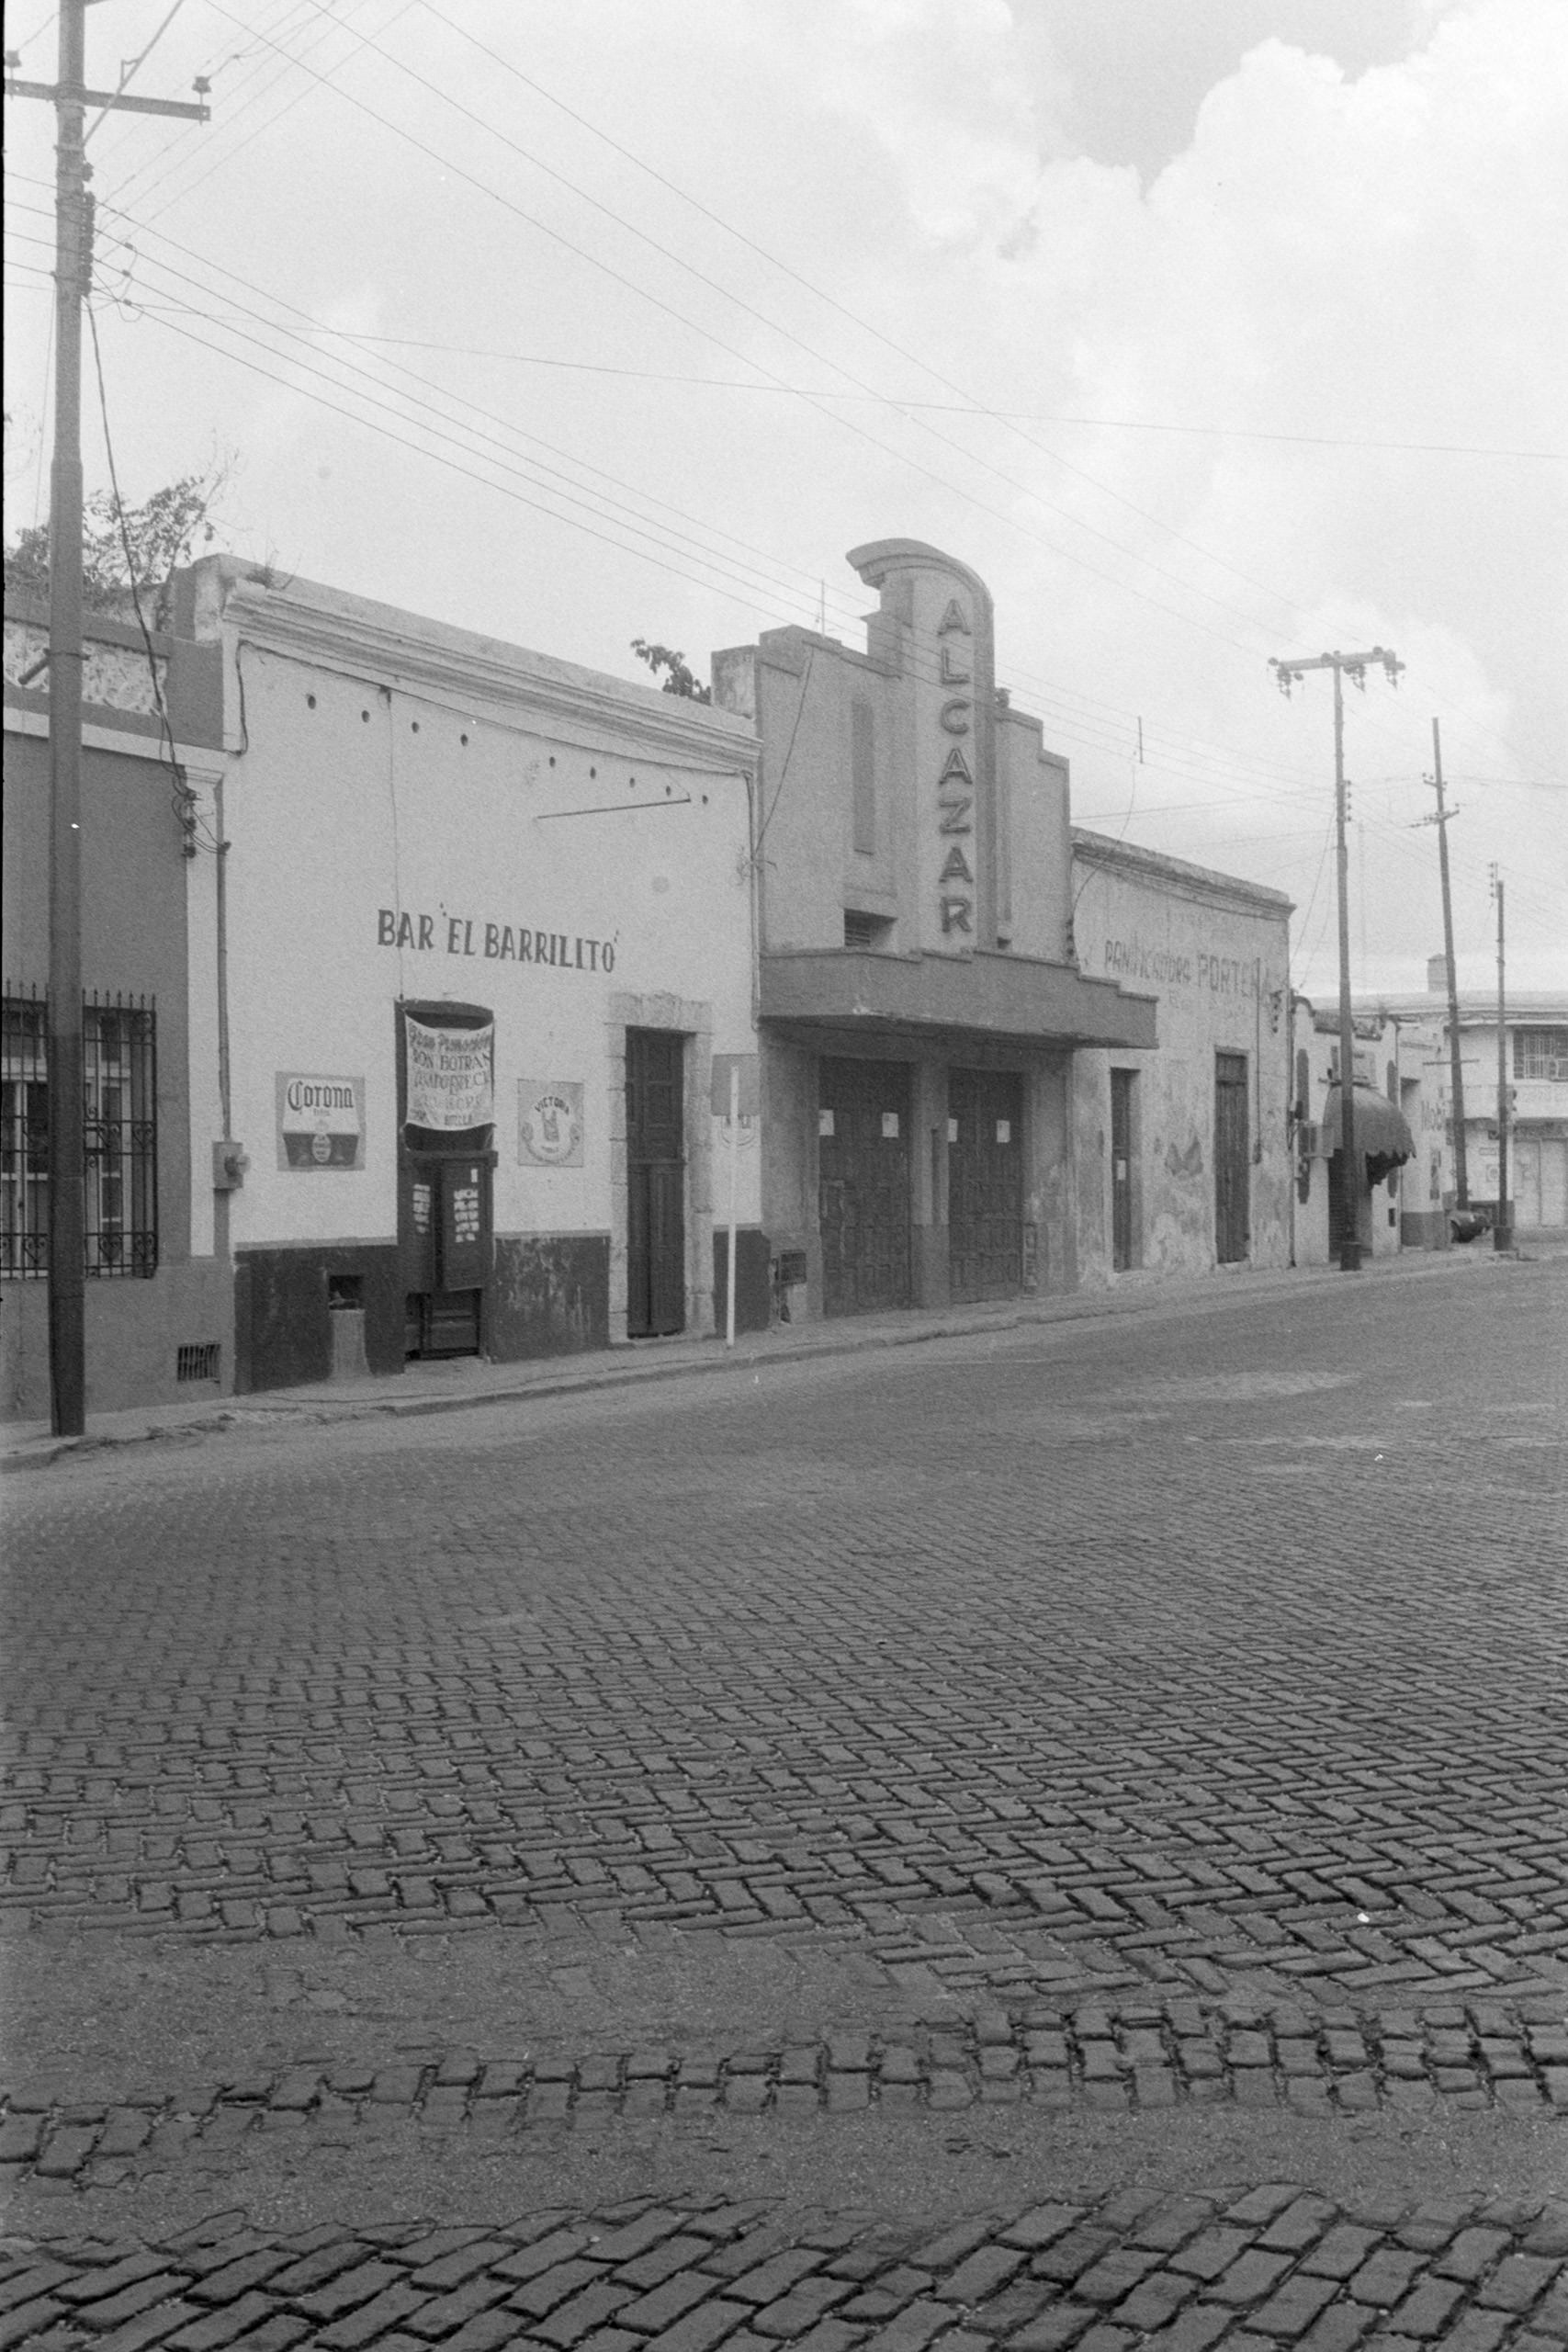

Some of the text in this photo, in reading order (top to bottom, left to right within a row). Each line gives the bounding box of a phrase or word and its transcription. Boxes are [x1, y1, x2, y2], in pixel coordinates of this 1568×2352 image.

[937, 598, 974, 933] ALCAZAR
[377, 909, 434, 951] BAR
[440, 1052, 491, 1071] BOTRAN
[288, 1080, 355, 1113] Corona
